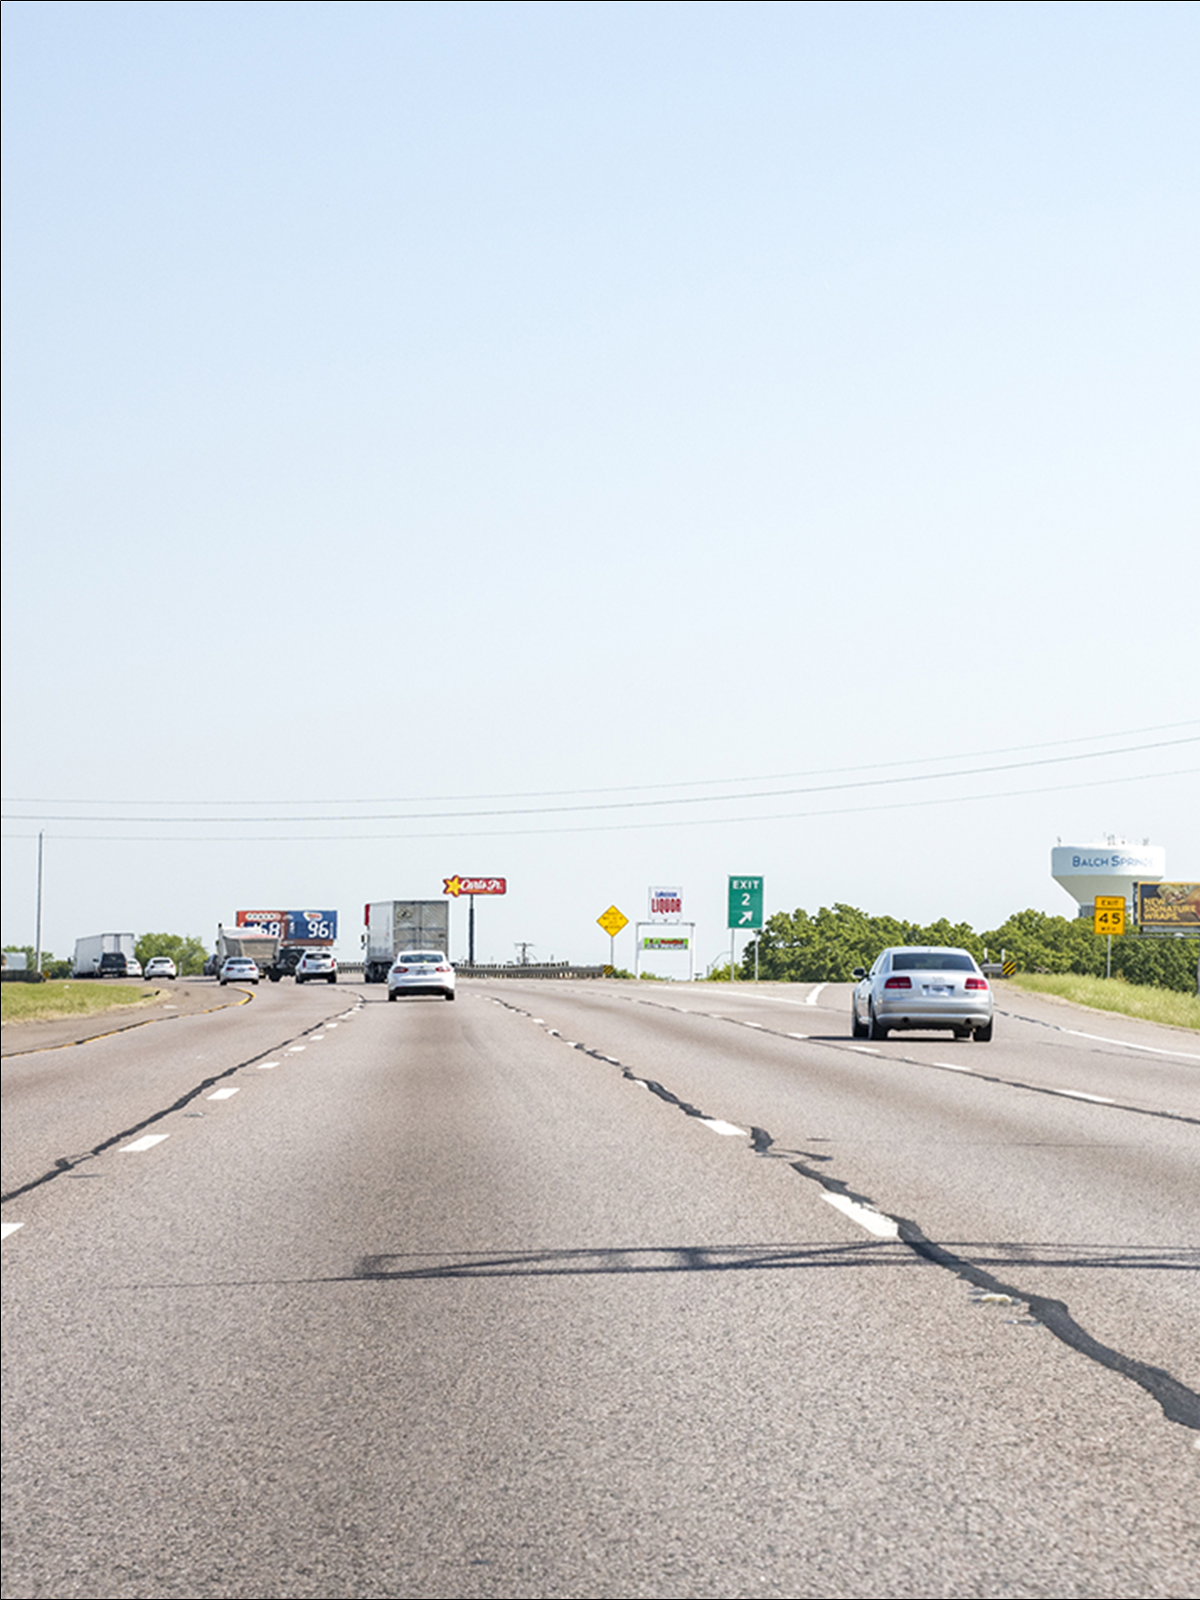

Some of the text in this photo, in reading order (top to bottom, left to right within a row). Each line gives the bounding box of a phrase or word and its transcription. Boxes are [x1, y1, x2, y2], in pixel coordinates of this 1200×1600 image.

[1072, 855, 1109, 868] BALCH
[732, 880, 760, 890] EXIT
[651, 898, 682, 914] LIQUOR
[741, 893, 751, 906] 2
[1098, 912, 1121, 925] 45
[307, 920, 329, 938] 96
